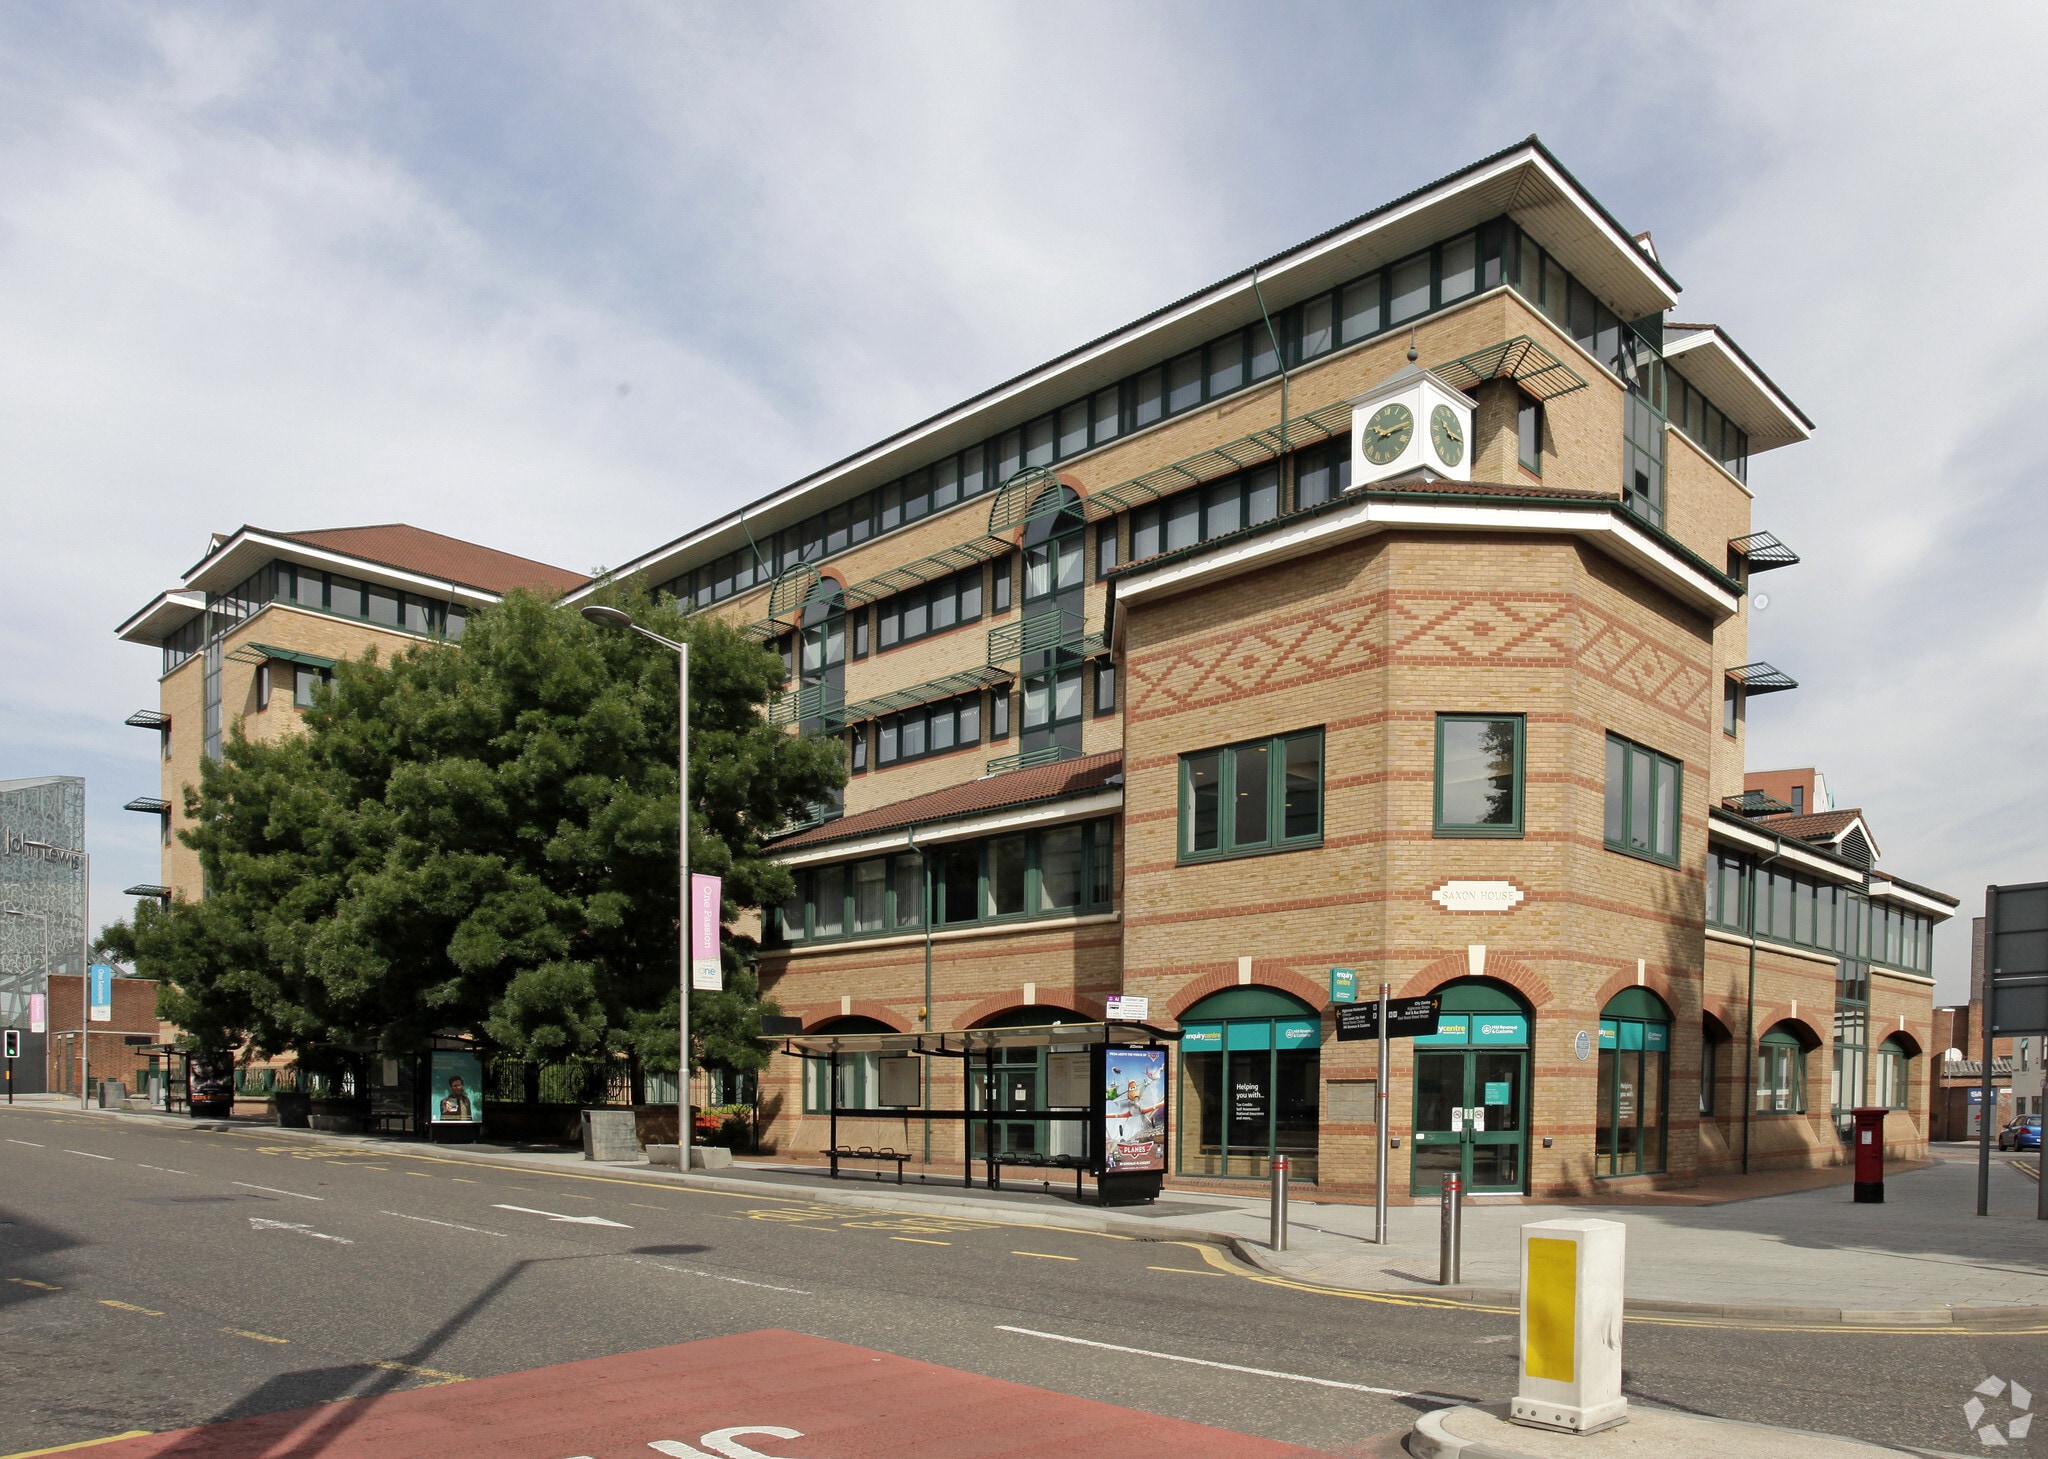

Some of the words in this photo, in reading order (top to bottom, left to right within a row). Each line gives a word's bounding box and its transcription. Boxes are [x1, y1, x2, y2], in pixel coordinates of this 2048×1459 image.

[43, 838, 80, 870] Lewis
[704, 886, 712, 907] One
[1442, 891, 1476, 900] SAXON
[1481, 891, 1514, 900] HOUSE
[704, 910, 712, 949] Passion
[1337, 972, 1353, 980] enquiry
[1236, 1083, 1259, 1091] Helping
